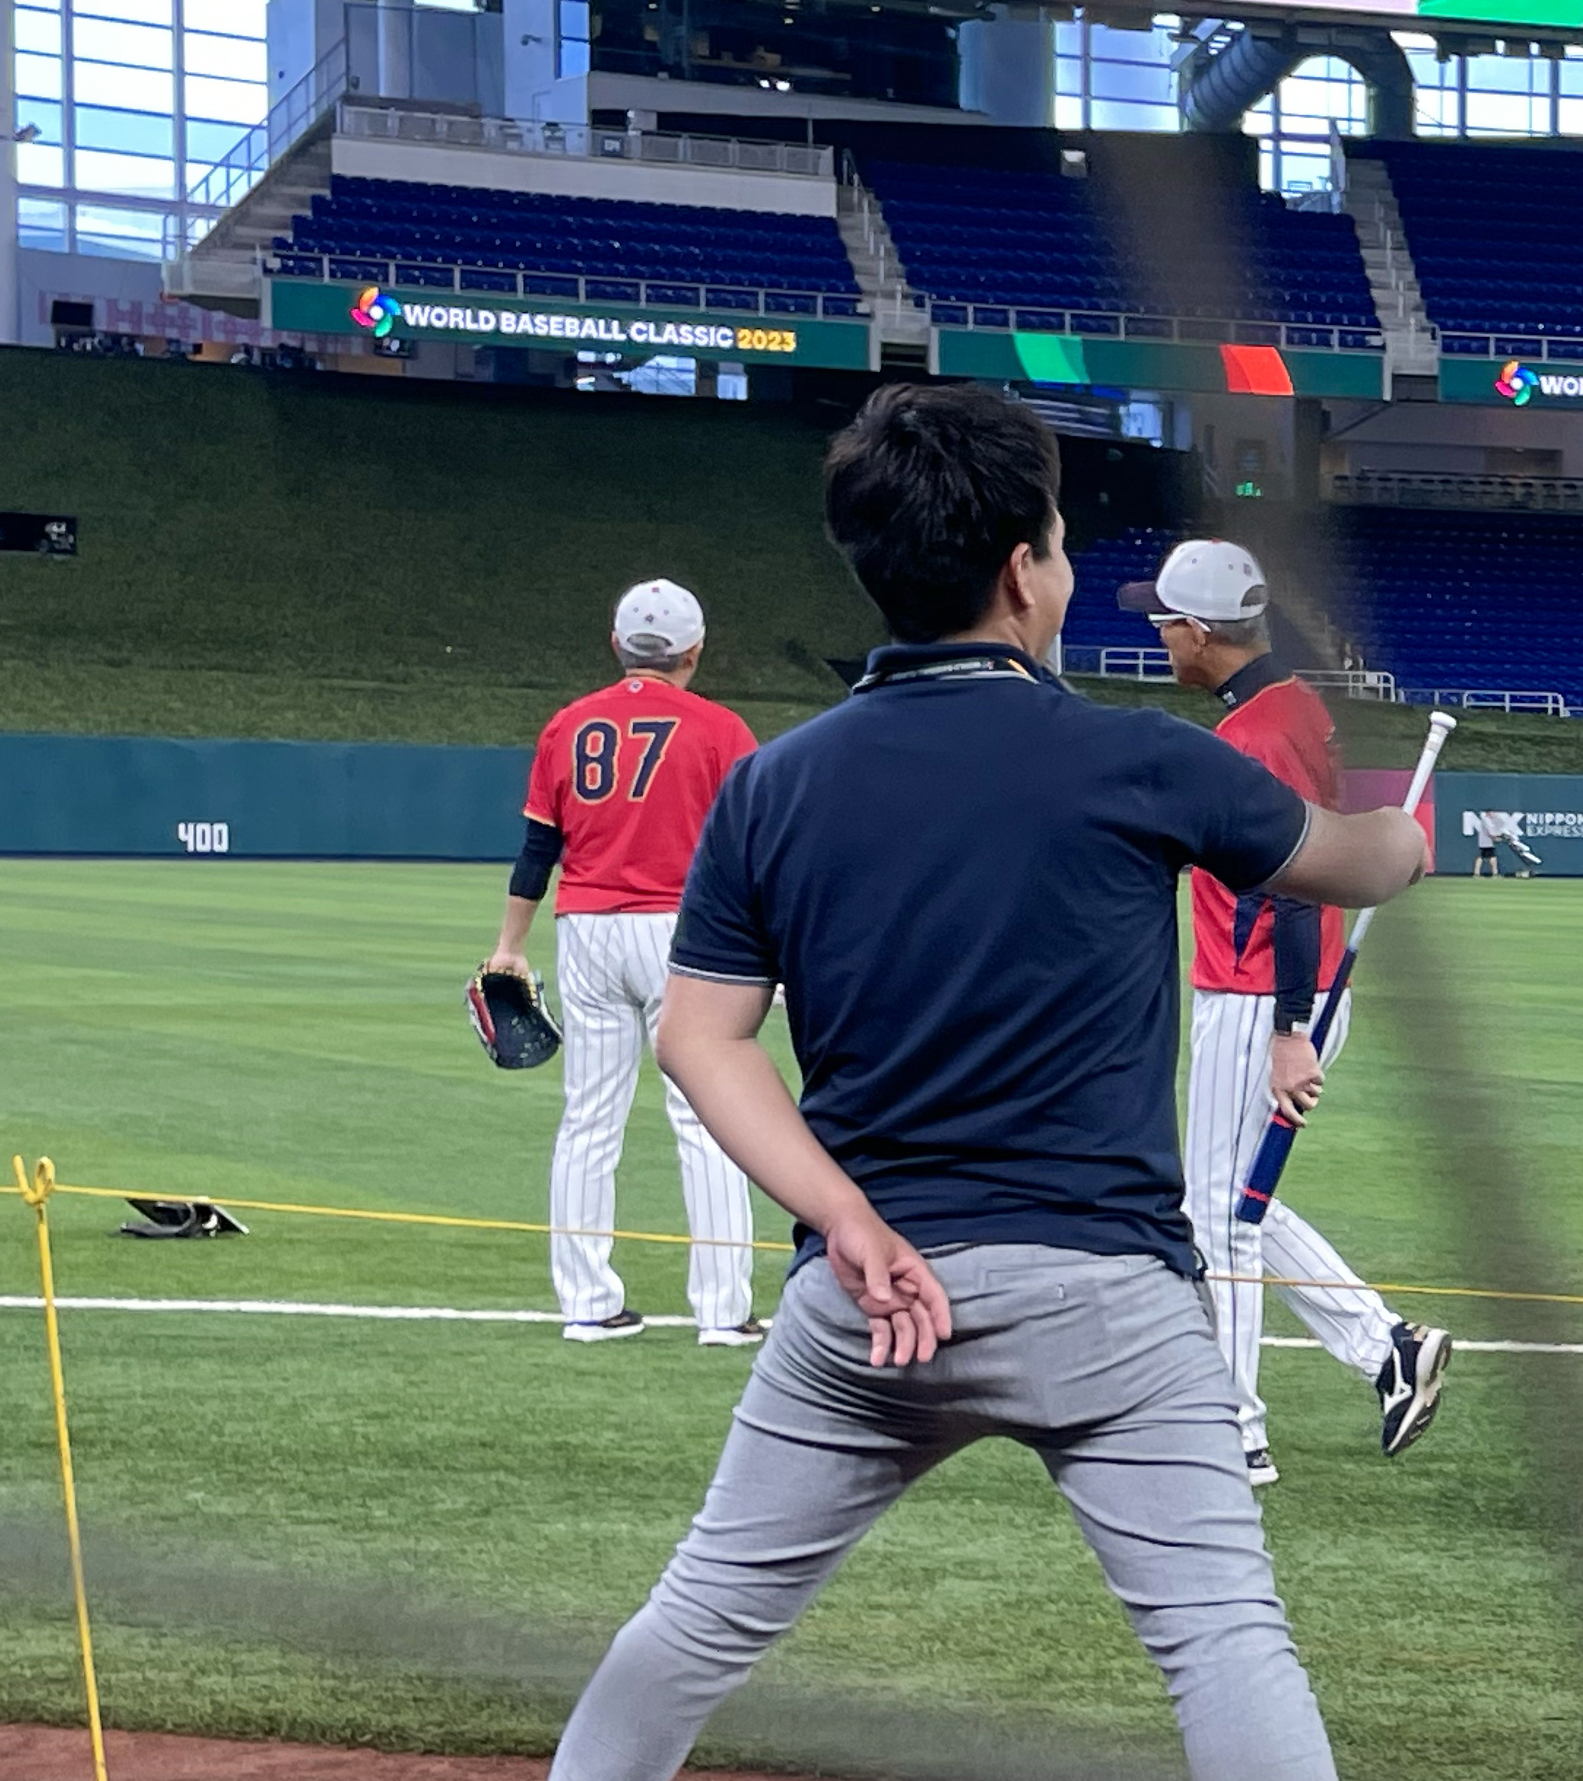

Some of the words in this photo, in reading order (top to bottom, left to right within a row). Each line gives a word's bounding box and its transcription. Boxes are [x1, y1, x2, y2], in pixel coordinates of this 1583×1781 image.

[402, 304, 495, 329] WORLD
[500, 312, 626, 342] BASEBALL
[629, 321, 733, 348] CLASSIC
[736, 328, 797, 352] 2023
[572, 716, 681, 805] 87
[178, 822, 229, 853] 400
